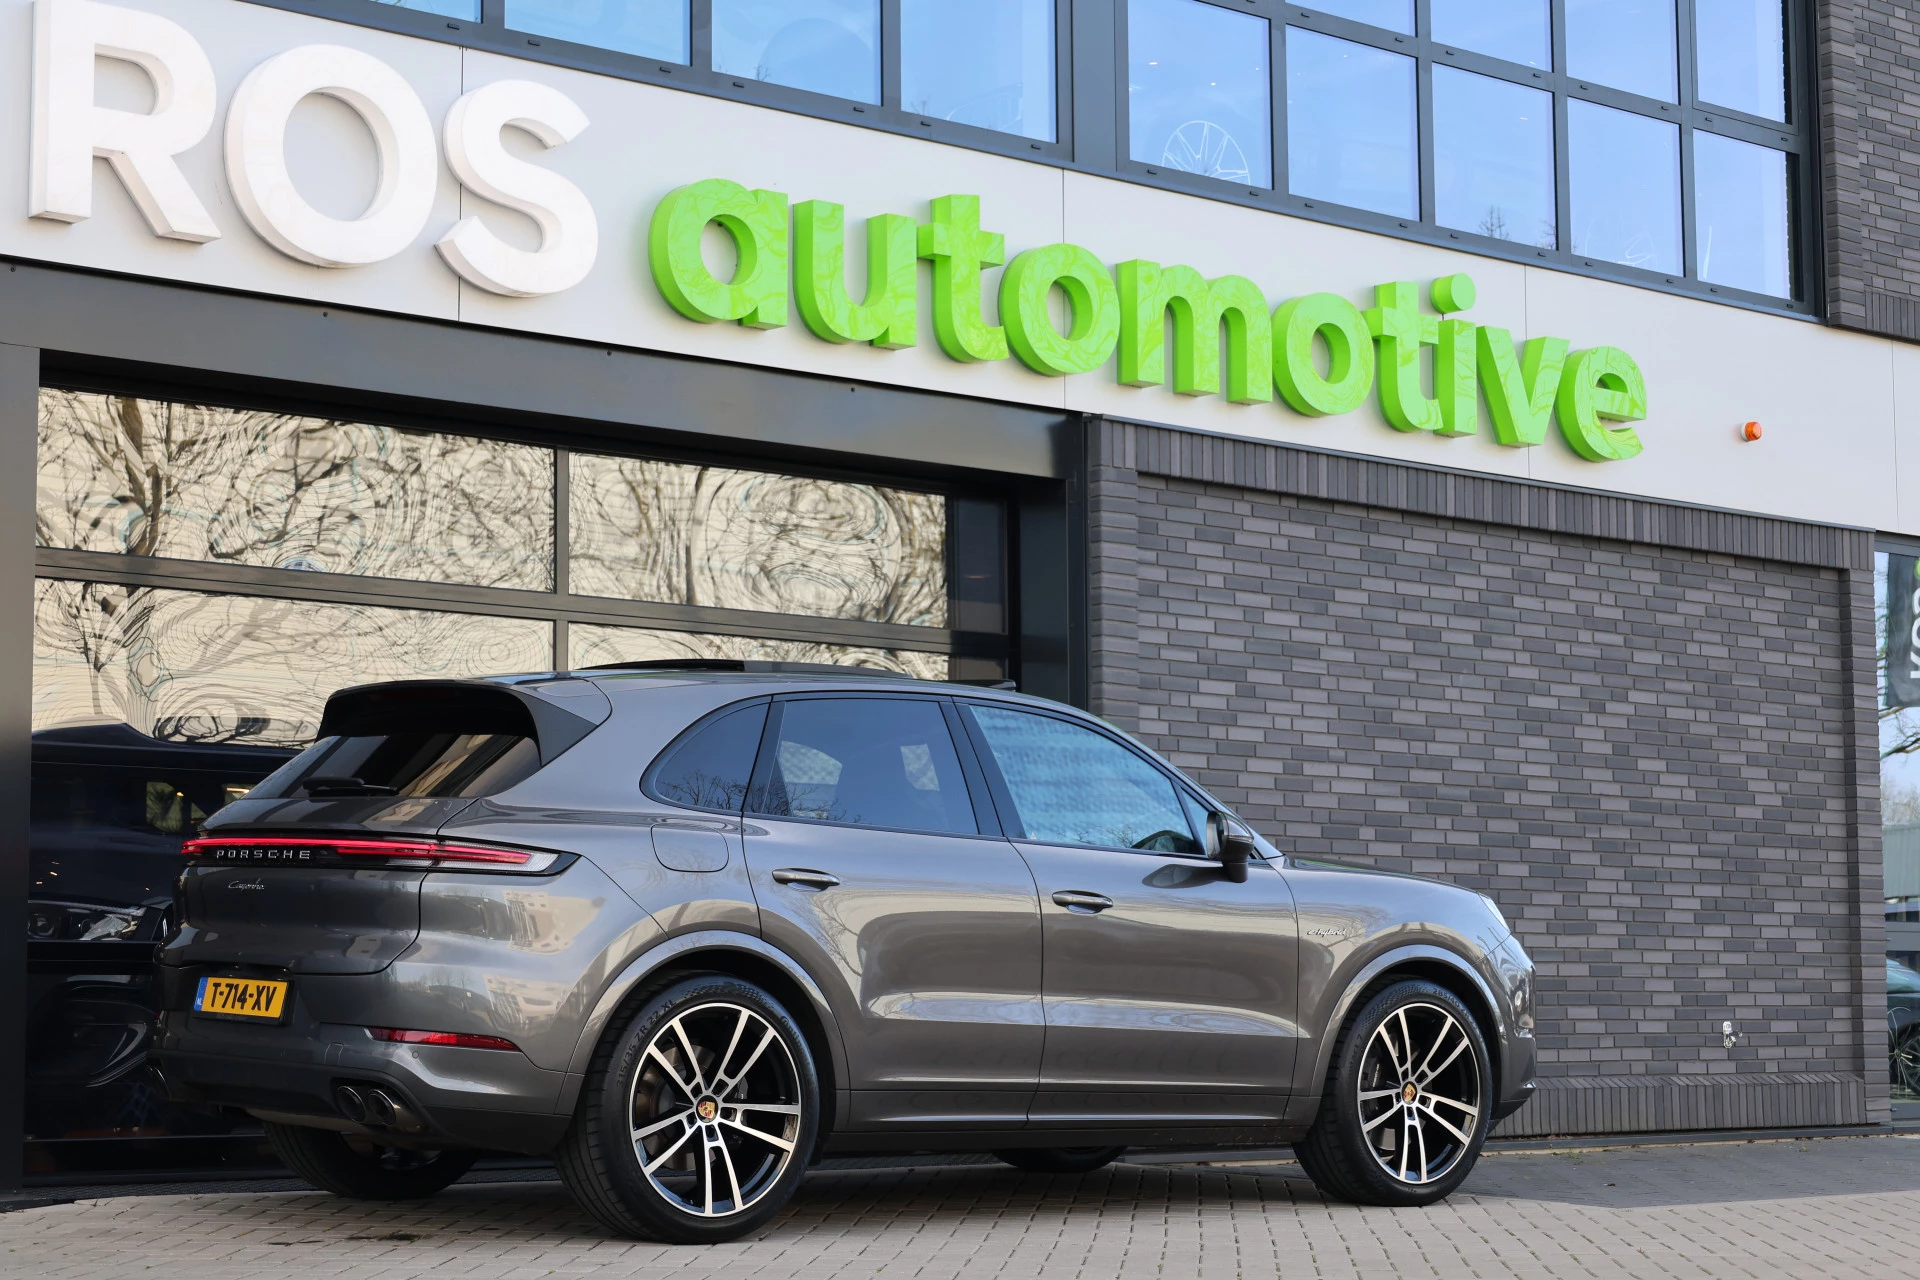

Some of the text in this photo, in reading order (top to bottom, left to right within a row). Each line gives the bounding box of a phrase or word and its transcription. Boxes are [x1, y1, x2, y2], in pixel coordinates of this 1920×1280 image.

[29, 0, 1648, 460] ROS automotive
[216, 849, 311, 859] PORSCHE
[211, 982, 277, 1011] T-714-XV
